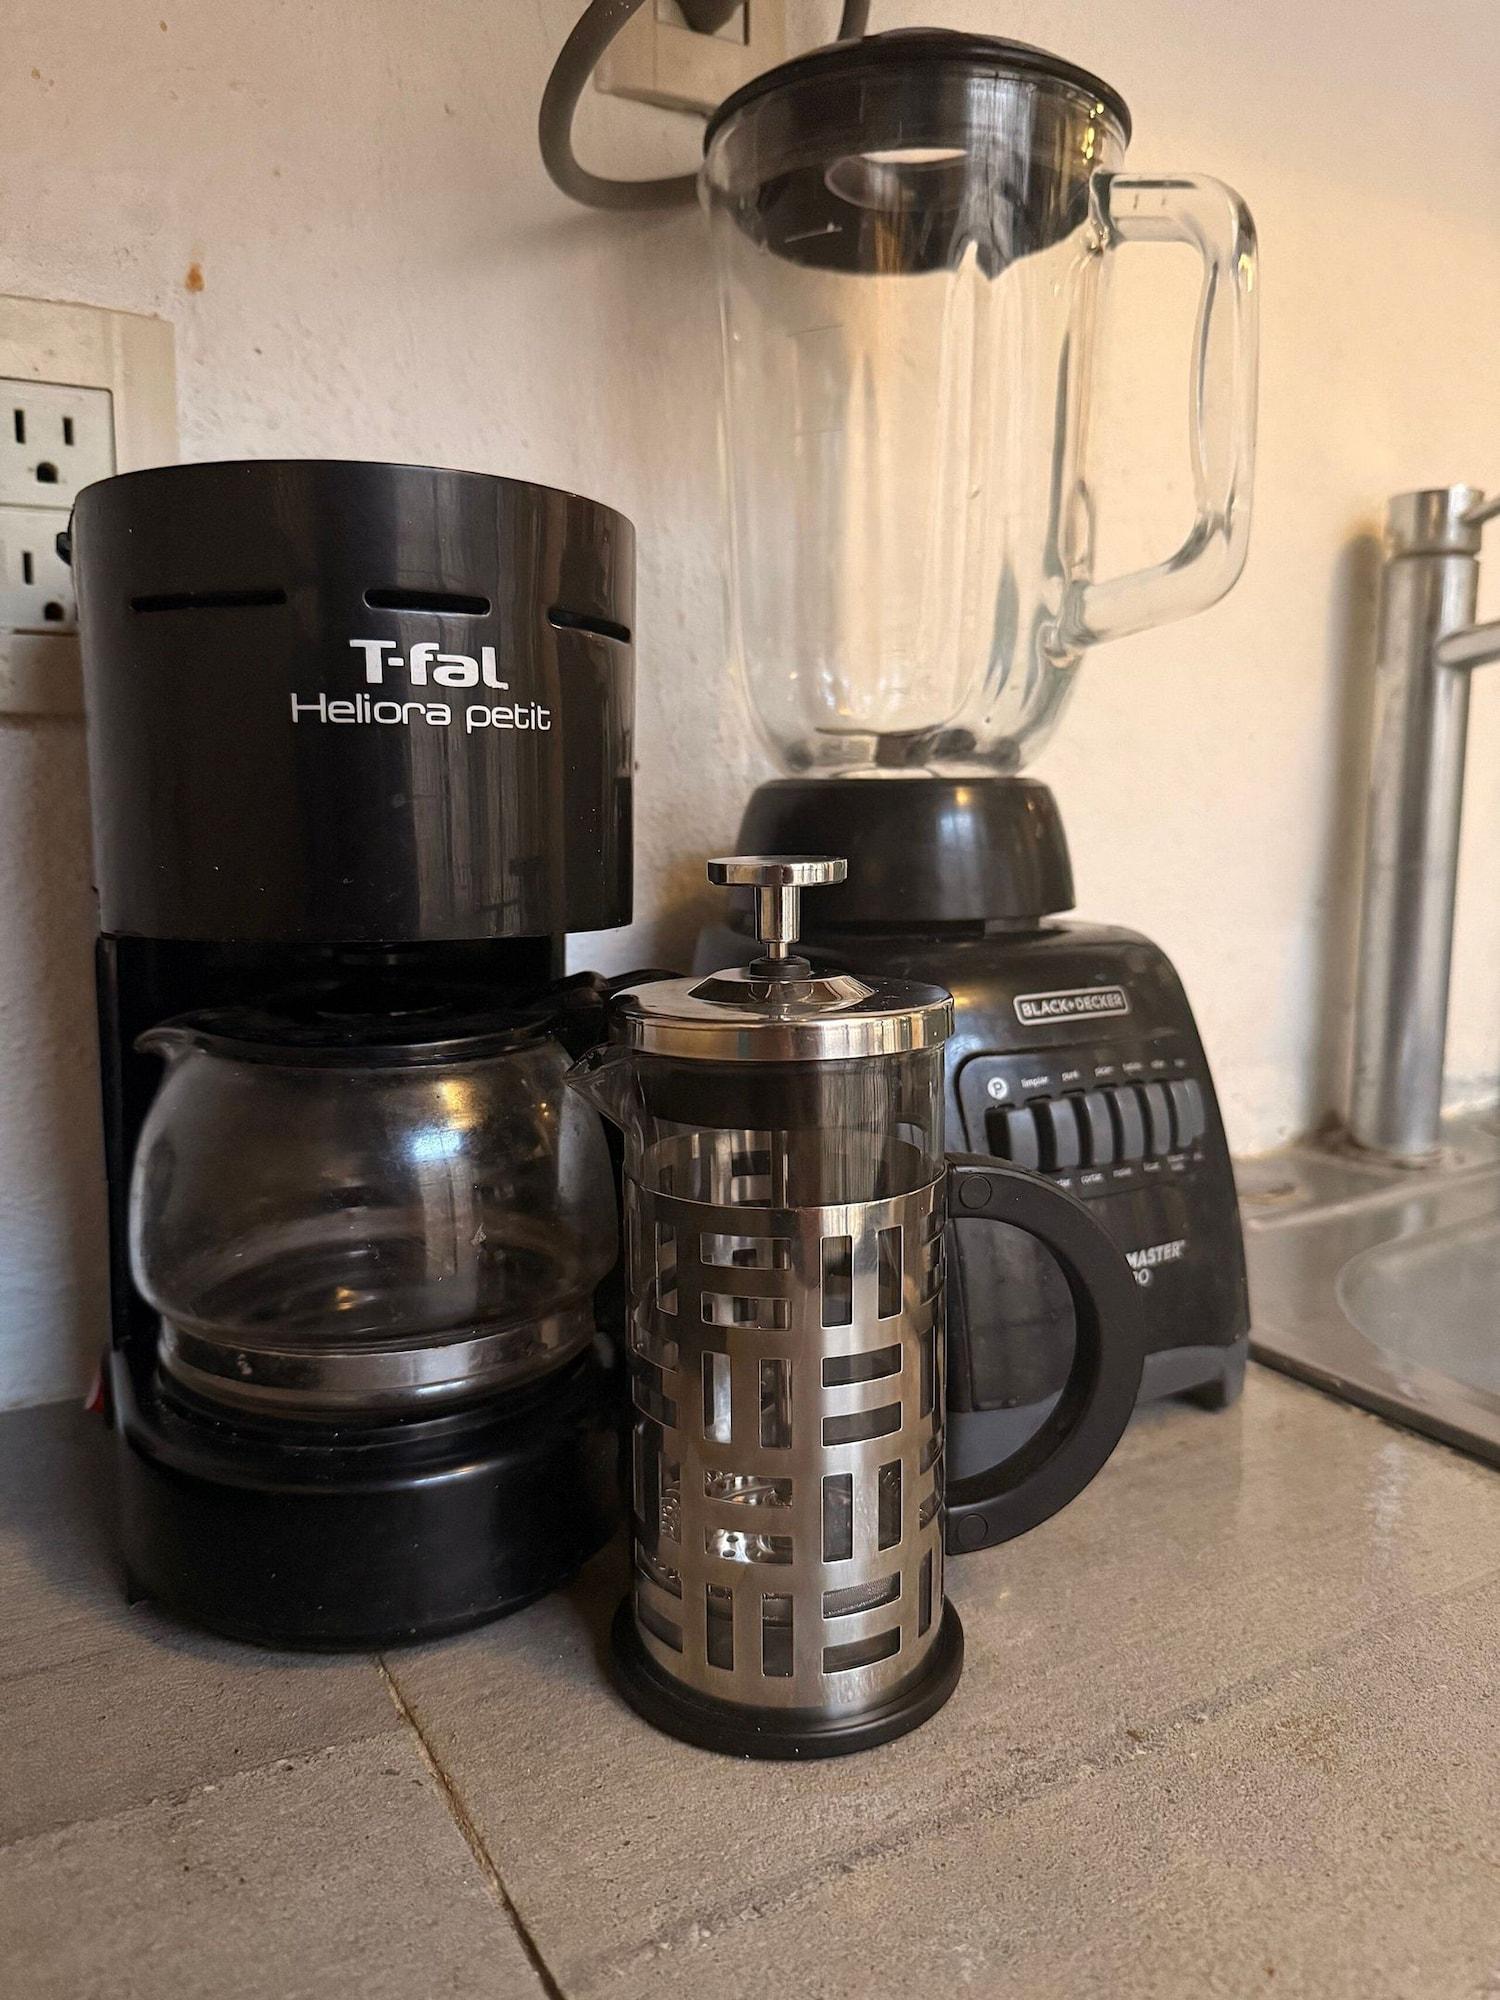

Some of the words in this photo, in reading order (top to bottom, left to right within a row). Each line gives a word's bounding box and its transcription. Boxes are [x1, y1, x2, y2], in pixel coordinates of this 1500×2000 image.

[350, 639, 509, 691] T-fal
[291, 692, 452, 727] Heliora
[466, 700, 552, 735] petit
